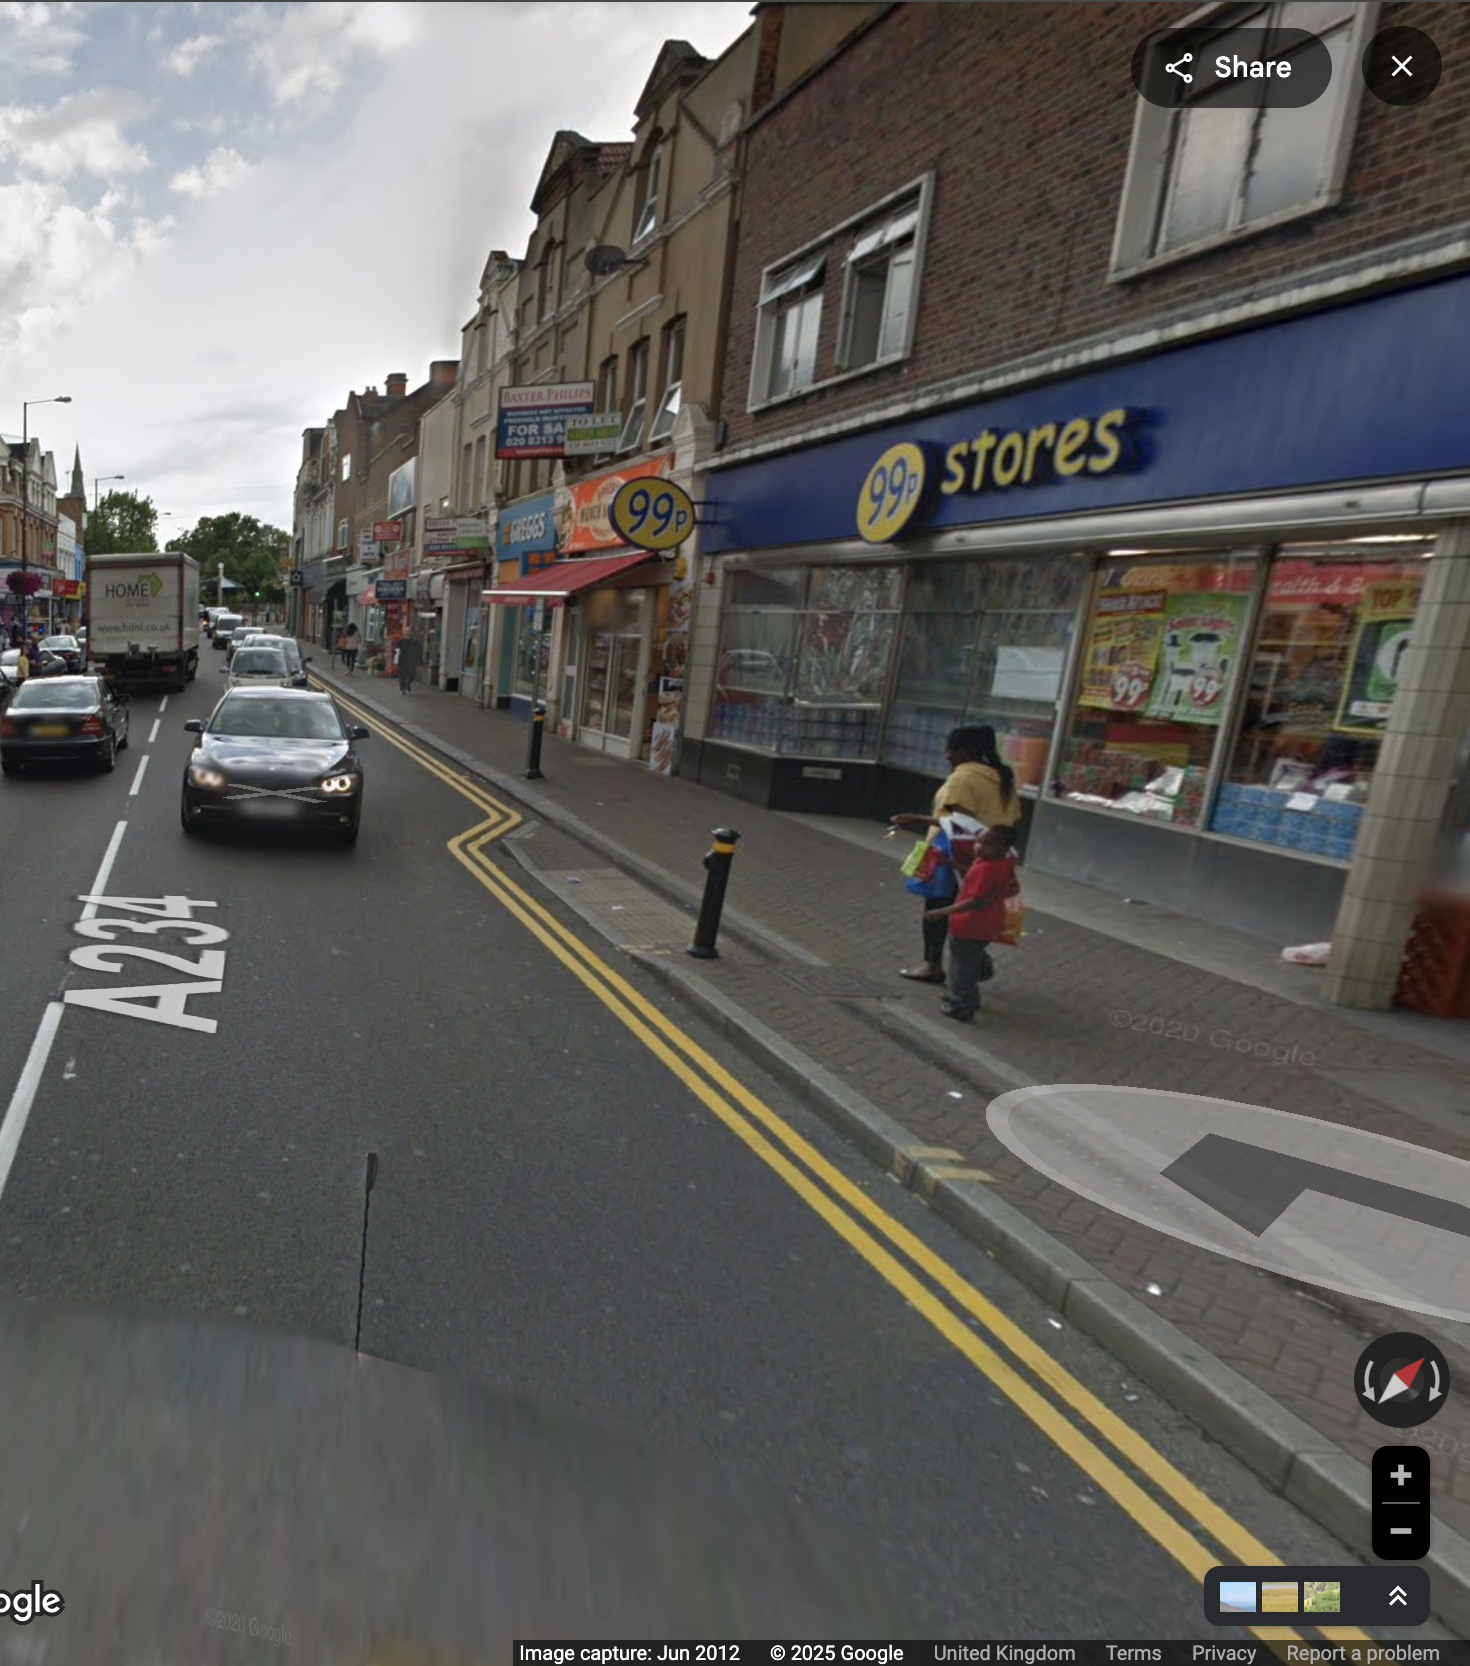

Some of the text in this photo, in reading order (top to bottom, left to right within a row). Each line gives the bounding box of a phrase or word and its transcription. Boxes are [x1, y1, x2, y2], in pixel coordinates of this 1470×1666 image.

[503, 391, 544, 403] BAXTER
[508, 422, 564, 436] FOR SA
[506, 436, 525, 447] 020
[867, 408, 1127, 528] 99p stores
[628, 488, 688, 537] 99p
[510, 511, 546, 545] GREGGS
[105, 582, 149, 598] HOME
[98, 621, 171, 633] www.hdnl.co.uk
[63, 894, 230, 1034] A234
